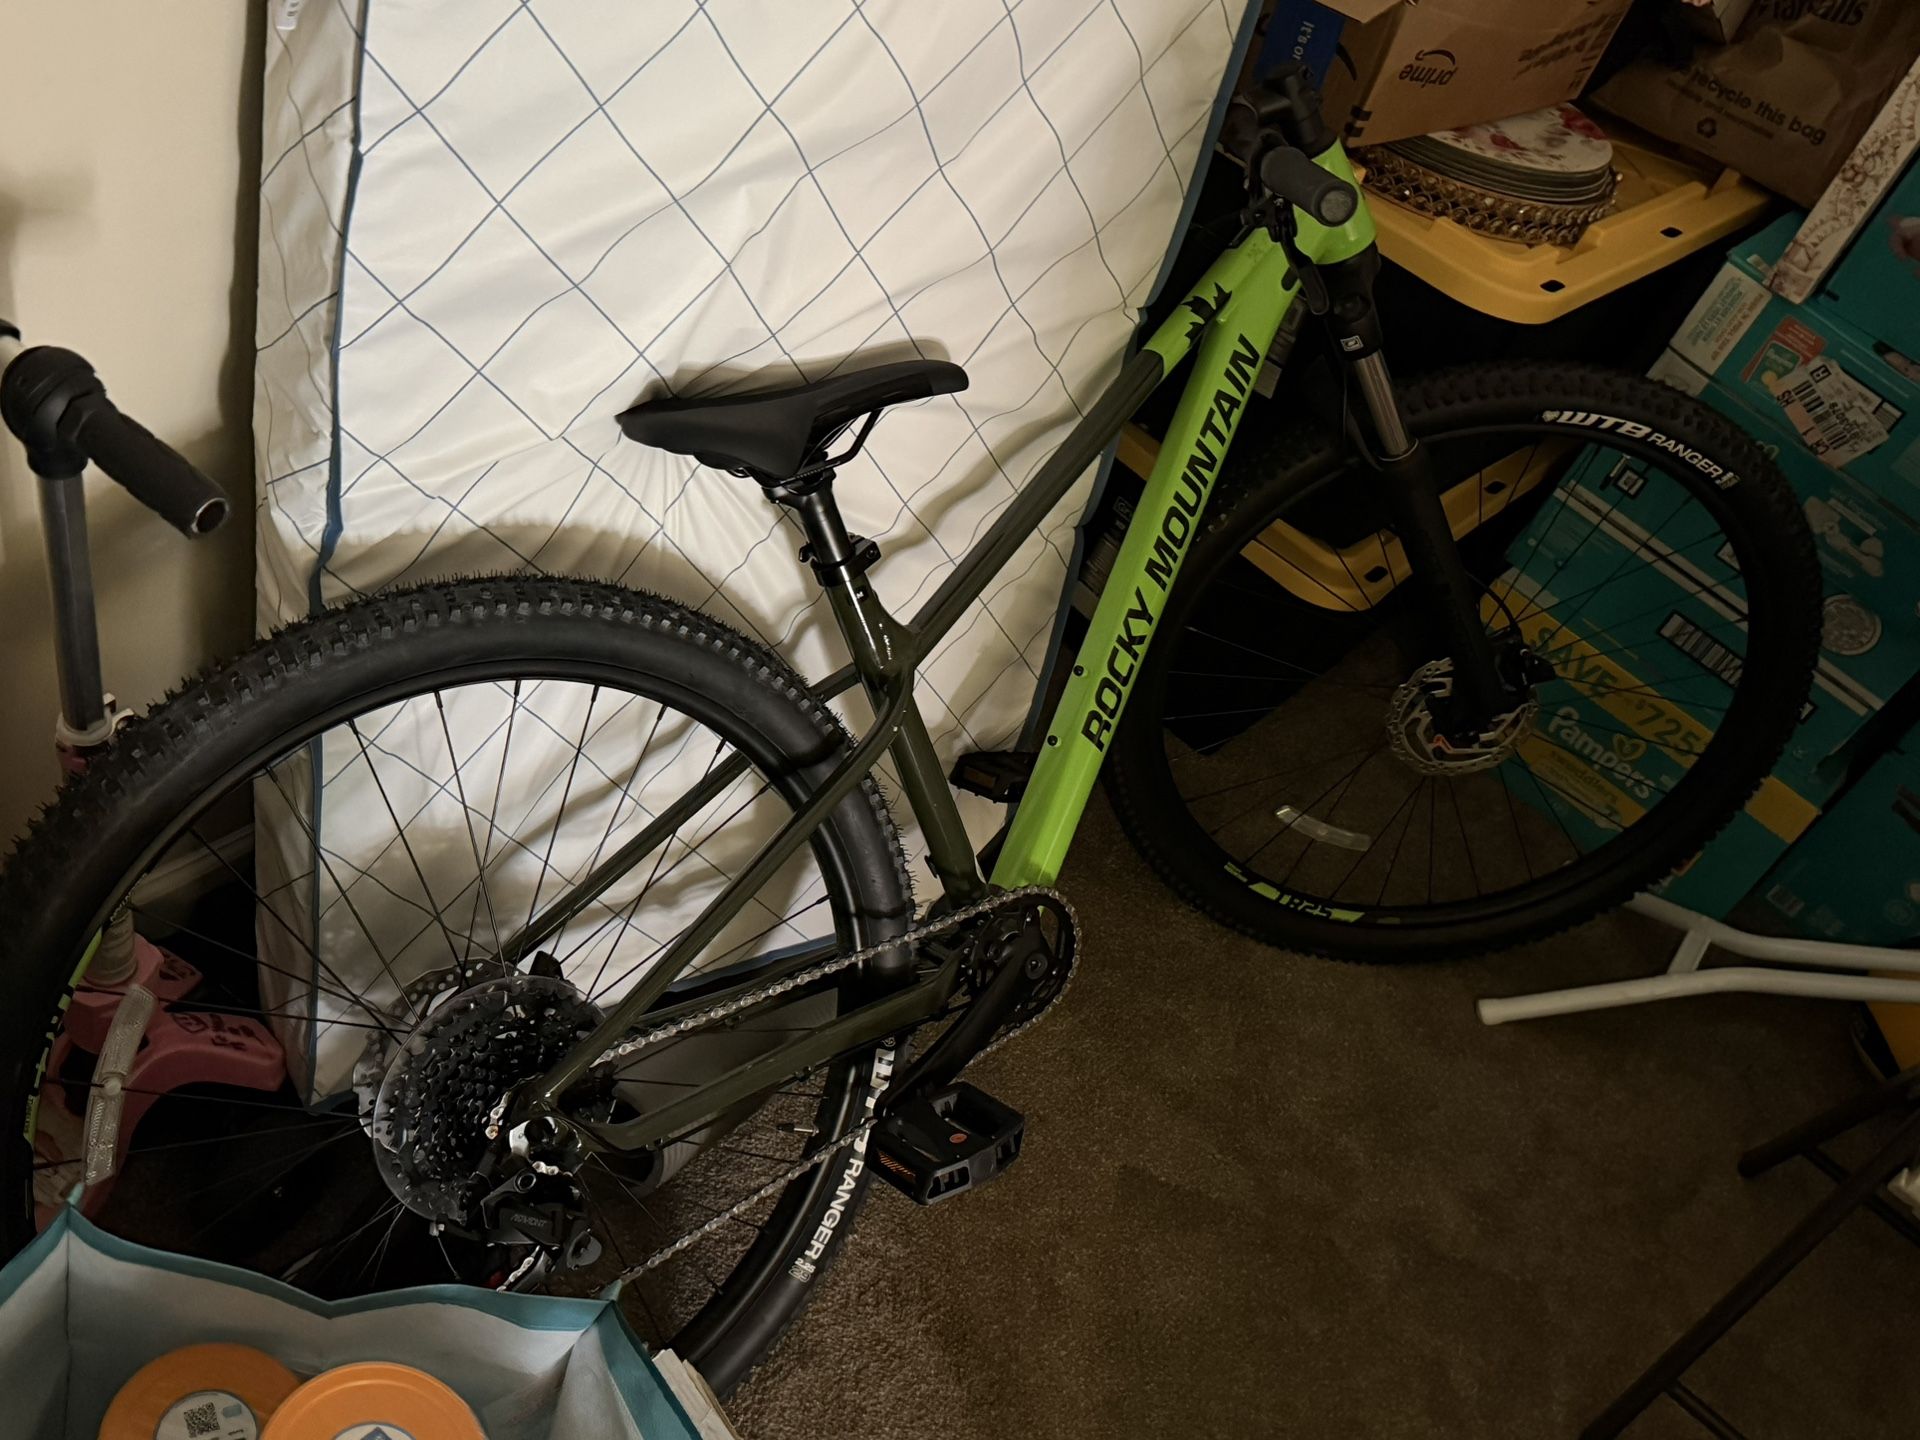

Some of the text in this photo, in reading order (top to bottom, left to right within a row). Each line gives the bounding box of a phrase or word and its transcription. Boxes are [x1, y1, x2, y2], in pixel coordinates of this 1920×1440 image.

[1399, 64, 1458, 88] prime
[1752, 100, 1787, 126] this
[1788, 116, 1827, 146] bag
[1556, 410, 1724, 481] WTB RANGER
[1082, 333, 1260, 752] ROCKY MOUNTAIN
[1548, 706, 1656, 799] Pampers
[804, 1158, 864, 1262] RANGER
